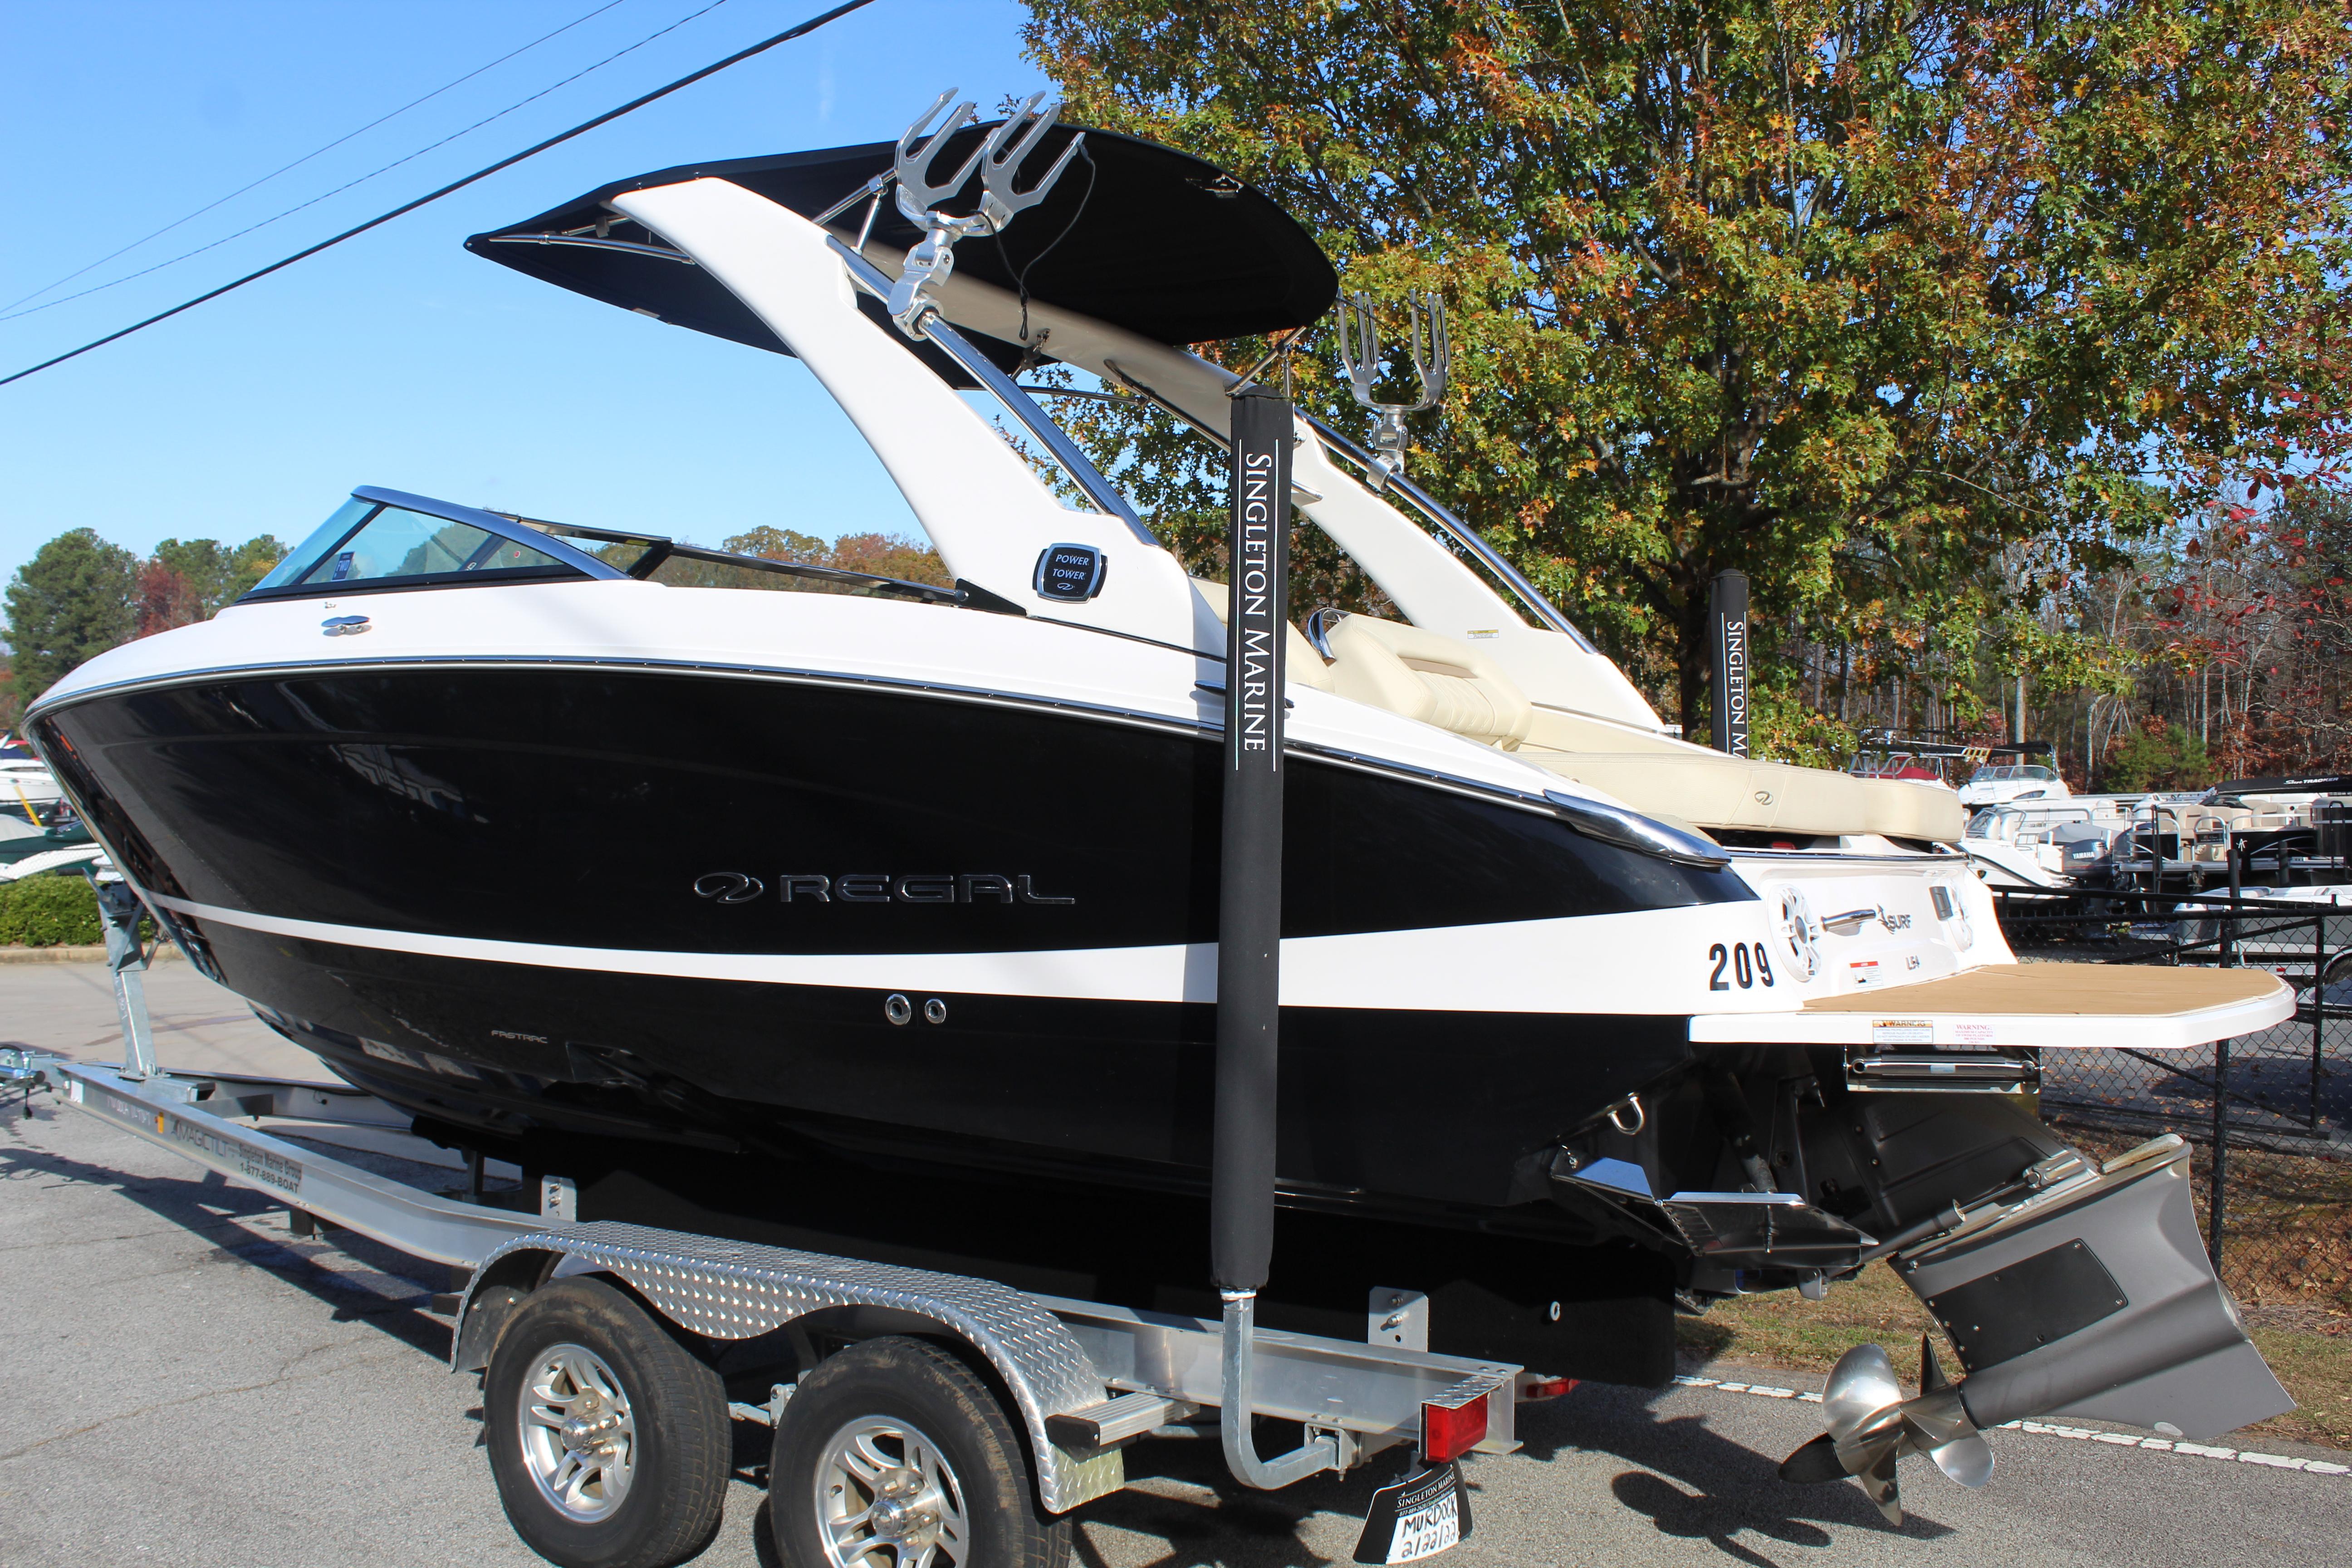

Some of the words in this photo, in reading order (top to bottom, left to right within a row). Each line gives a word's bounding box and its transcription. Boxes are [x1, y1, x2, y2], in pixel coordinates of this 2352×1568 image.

[1245, 453, 1272, 616] SINGLETON
[1053, 568, 1085, 580] TOWER
[1056, 554, 1089, 566] POWER
[1244, 628, 1270, 752] MARINE
[1727, 621, 1745, 725] SINGLETON
[2073, 851, 2095, 859] YAMAHA
[779, 874, 1076, 904] REGAL
[1887, 914, 1911, 930] SURF
[1709, 942, 1774, 991] 209
[491, 1030, 548, 1044] FASTRAC
[240, 1161, 299, 1194] 1-877-889-BOAT
[1397, 1484, 1437, 1509] SINGLETON
[1438, 1471, 1455, 1491] MARINE
[1402, 1495, 1457, 1538] MURDOCK
[1401, 1521, 1456, 1558] 2/22/22
